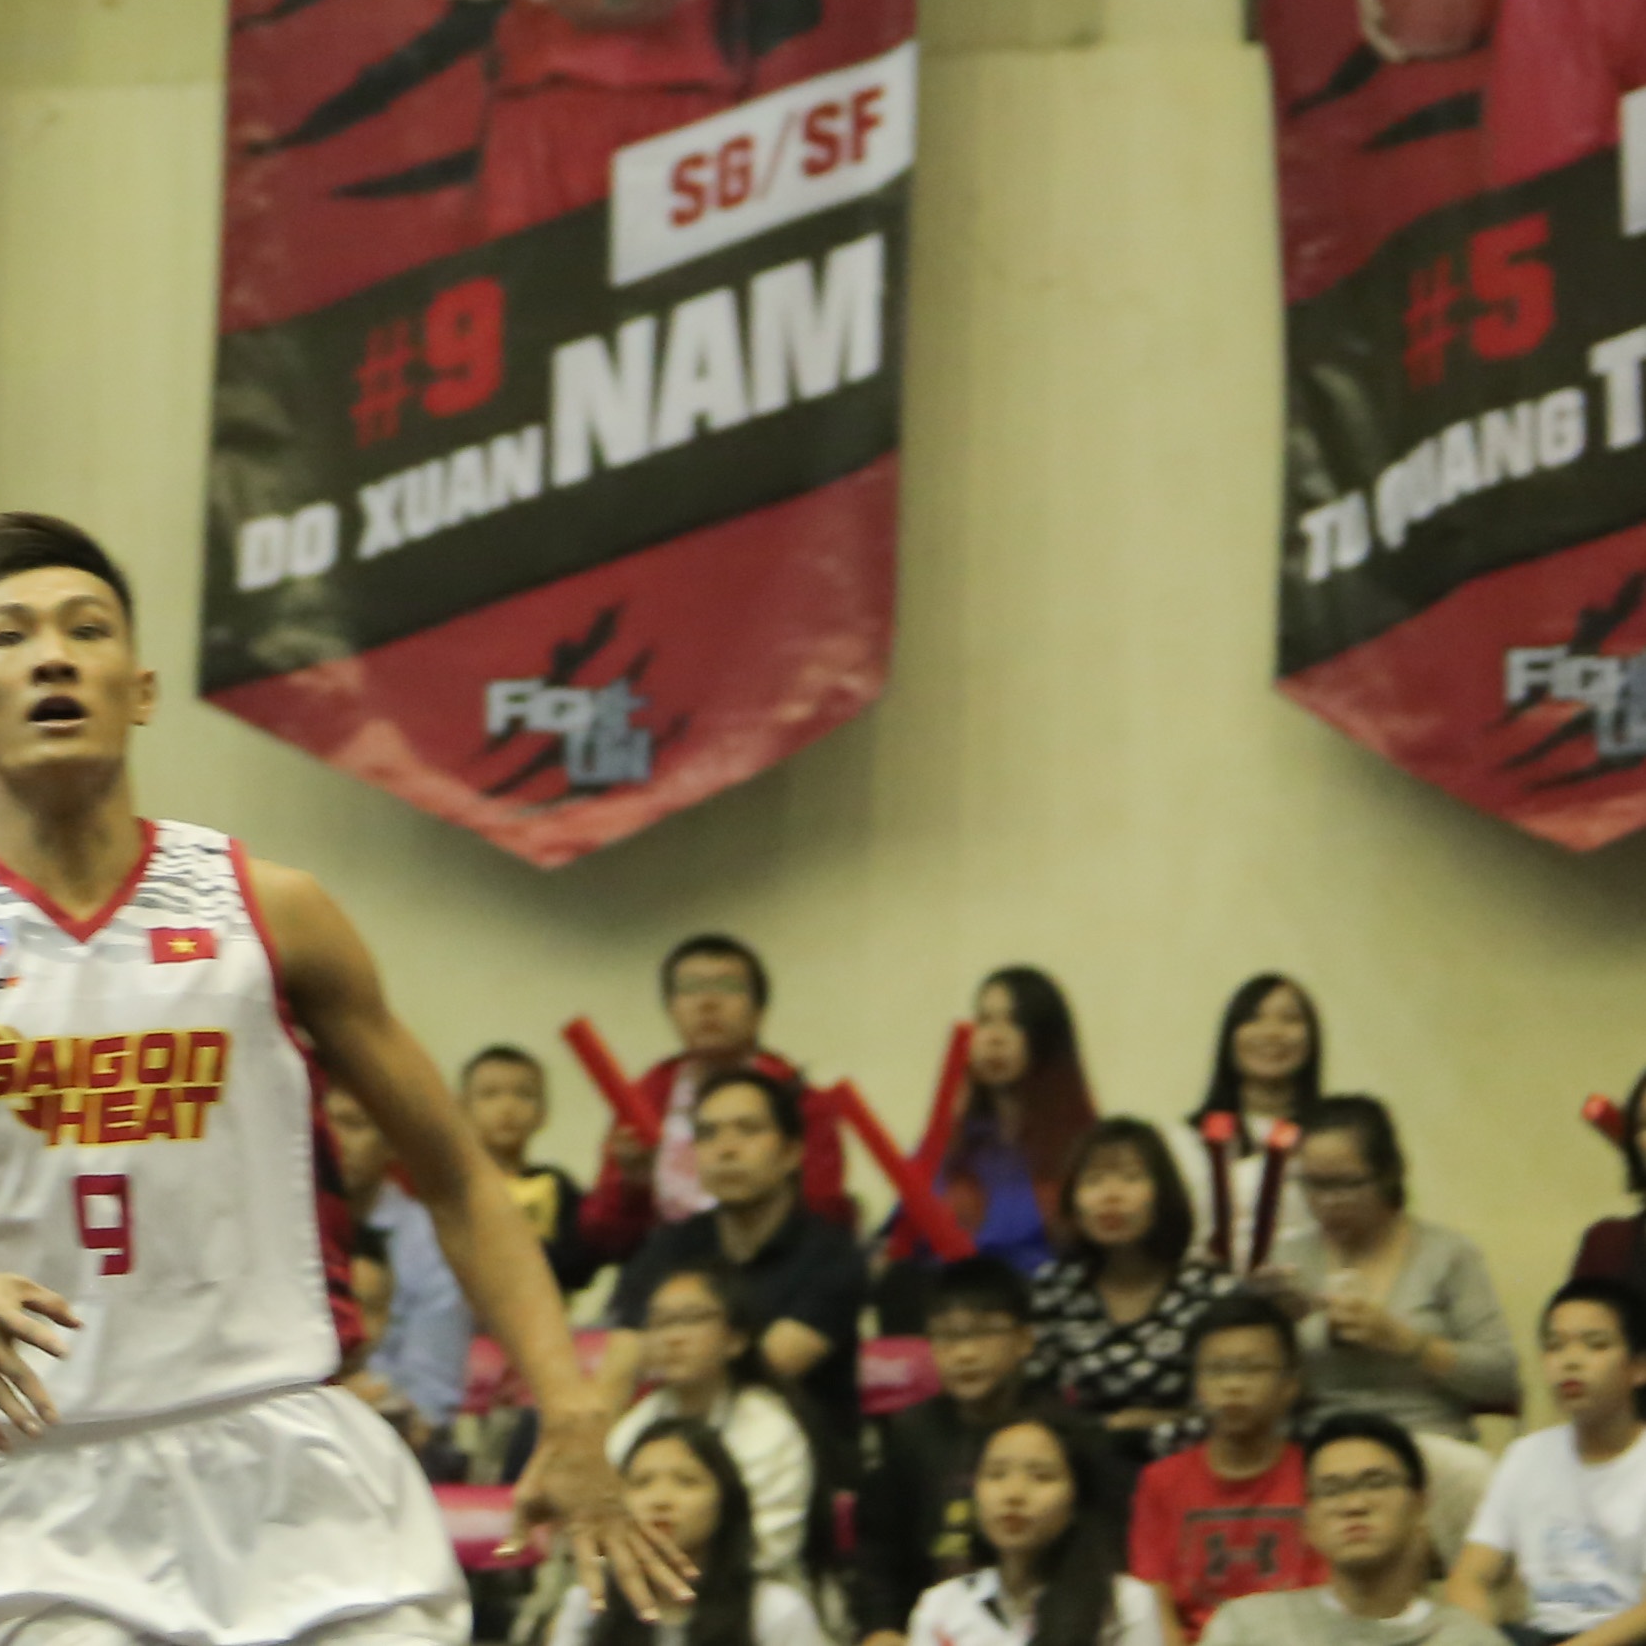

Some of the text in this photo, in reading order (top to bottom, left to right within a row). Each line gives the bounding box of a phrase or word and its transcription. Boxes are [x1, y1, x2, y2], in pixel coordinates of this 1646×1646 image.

[669, 86, 884, 228] SG/SF
[351, 275, 506, 448] #9
[1403, 212, 1556, 390] #5
[236, 233, 885, 594] DO XUAN NAM
[30, 1085, 221, 1149] HEAT
[72, 1173, 135, 1276] 9
